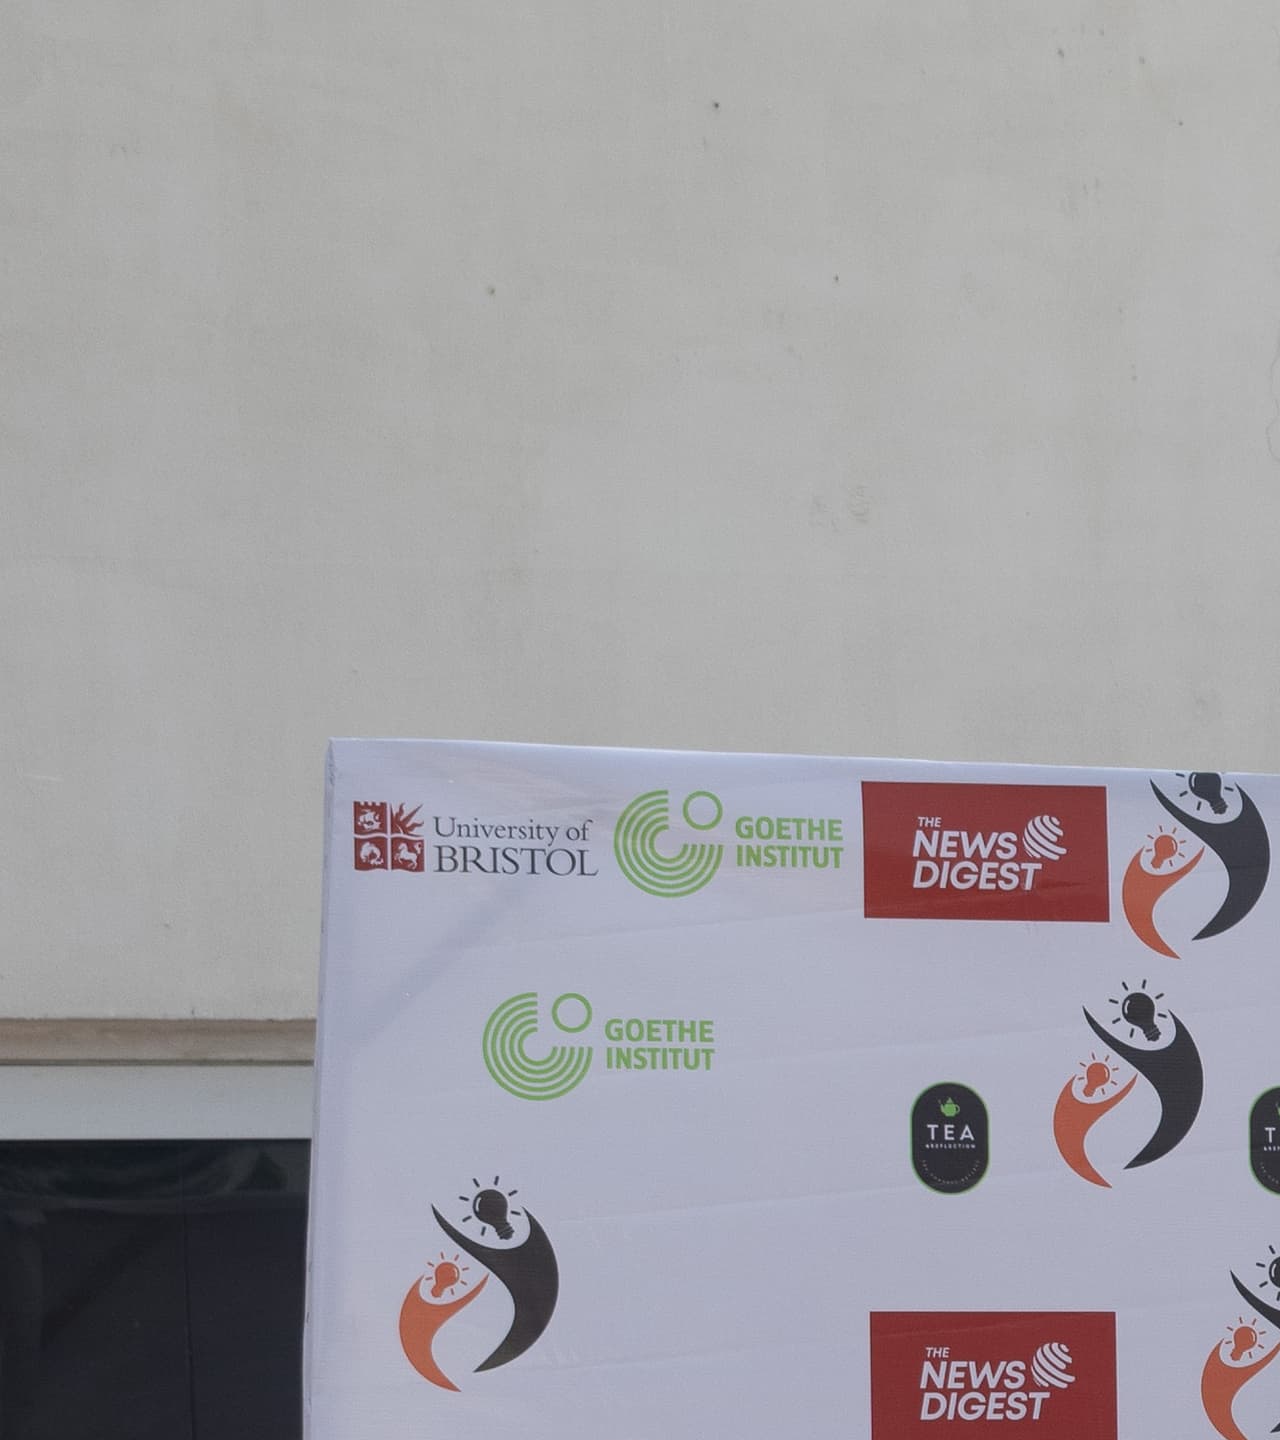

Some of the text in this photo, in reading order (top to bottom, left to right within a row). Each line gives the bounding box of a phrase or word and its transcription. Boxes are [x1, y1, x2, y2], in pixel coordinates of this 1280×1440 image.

[434, 817, 593, 846] University of
[735, 816, 843, 841] GOETHE
[918, 817, 941, 827] THE
[737, 845, 844, 868] INSTITUT
[913, 830, 1018, 859] NEWS
[435, 846, 598, 876] BRISTOL
[913, 861, 1042, 890] DIGEST
[605, 1019, 714, 1042] GOETHE
[607, 1047, 715, 1070] INSTITUT
[927, 1124, 974, 1140] TEA
